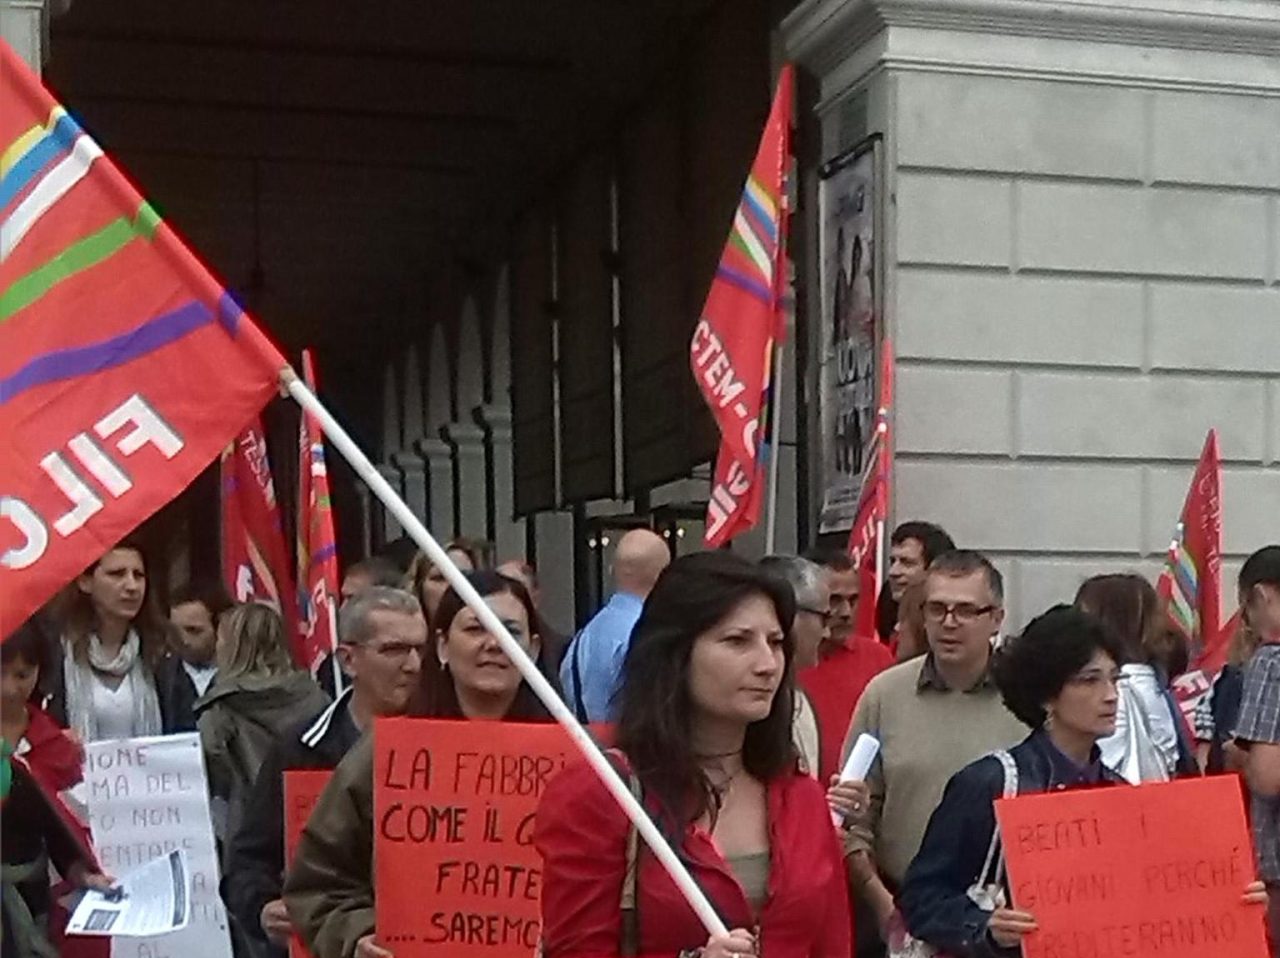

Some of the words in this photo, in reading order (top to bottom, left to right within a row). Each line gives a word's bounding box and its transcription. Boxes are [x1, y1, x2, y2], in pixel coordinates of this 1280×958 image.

[384, 748, 432, 792] LA
[381, 802, 468, 844] COME
[1017, 811, 1102, 854] BEATI
[435, 861, 542, 901] FRATE
[1017, 866, 1117, 909] GIOVANI
